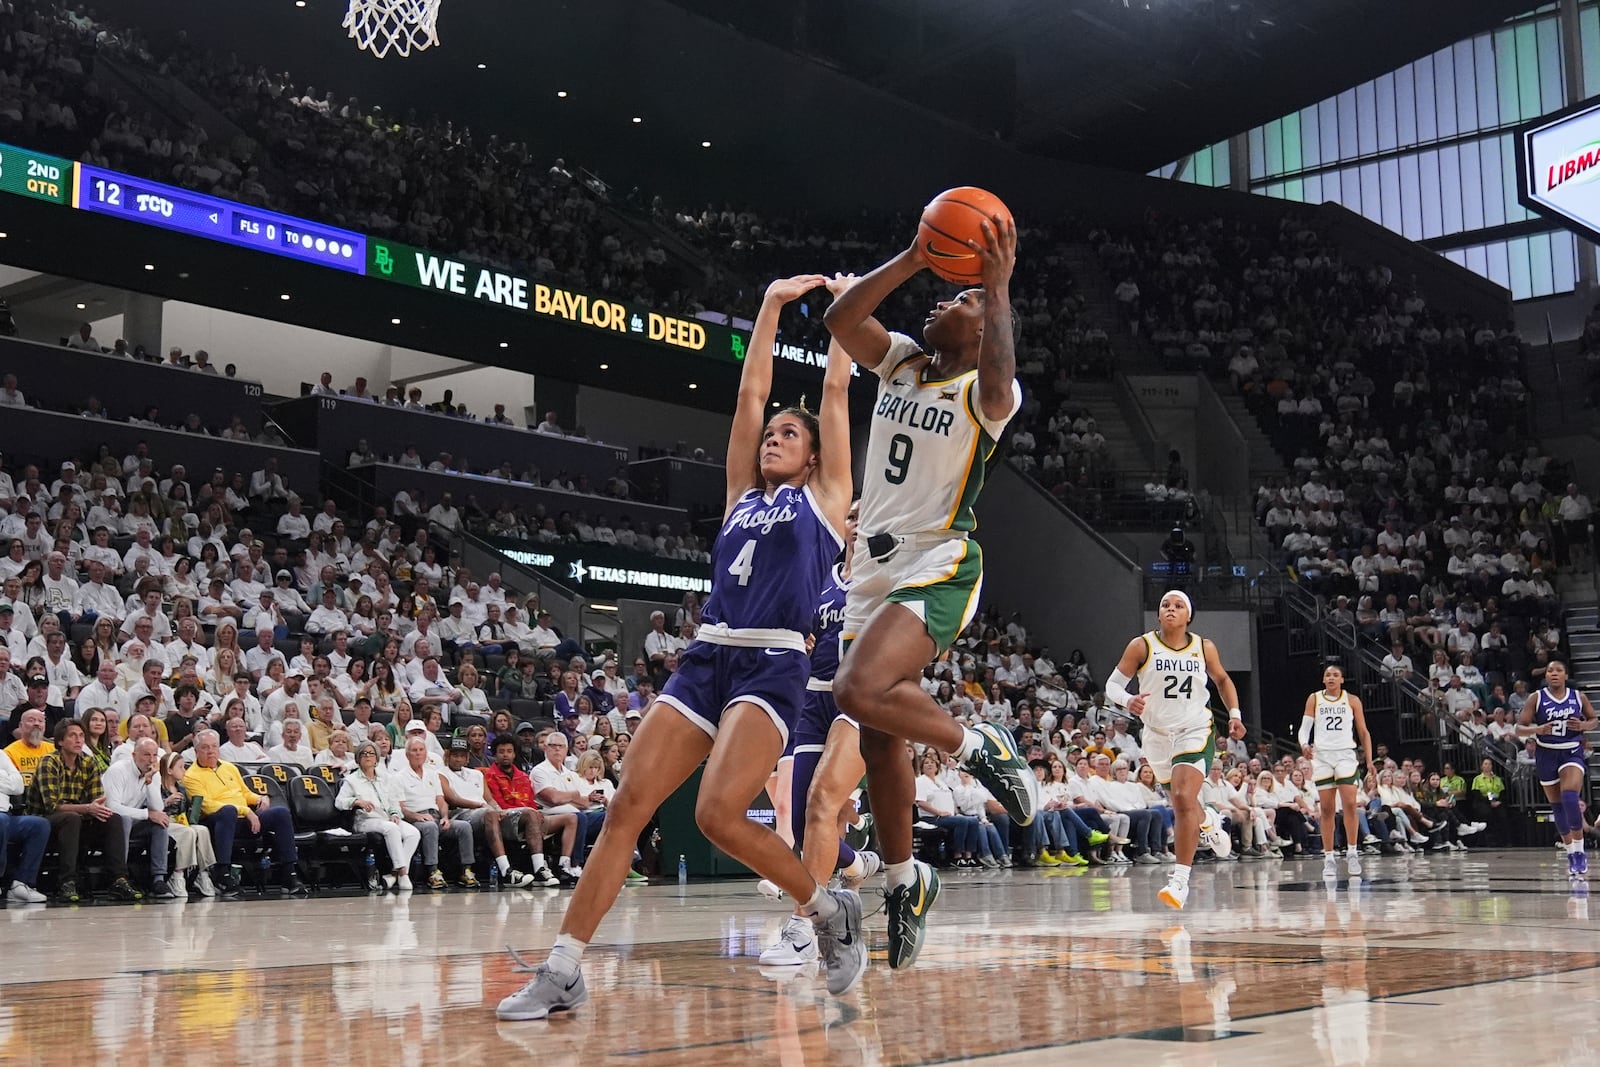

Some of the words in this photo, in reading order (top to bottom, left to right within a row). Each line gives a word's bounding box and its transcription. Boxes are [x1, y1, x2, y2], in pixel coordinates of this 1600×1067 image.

[27, 160, 60, 180] 2ND
[27, 179, 58, 197] QTR
[96, 180, 120, 205] 12
[136, 194, 174, 217] TCU
[240, 219, 260, 234] FLS
[266, 224, 276, 240] 0
[286, 231, 299, 244] TO
[415, 252, 466, 295] WE
[474, 269, 528, 310] ARE
[535, 284, 626, 333] BAYLOR
[648, 312, 706, 350] DEED
[781, 344, 804, 363] ARE
[806, 350, 815, 366] A
[244, 385, 261, 397] 120
[320, 398, 337, 410] 119
[876, 392, 954, 437] BAYLOR
[885, 433, 914, 485] 9
[723, 504, 797, 536] Frogs
[728, 539, 757, 586] 4
[588, 566, 627, 585] TEXAS
[627, 570, 659, 588] FARM
[659, 574, 703, 593] BUREAU
[1156, 659, 1200, 673] BAYLOR
[1164, 675, 1193, 699] 24
[1320, 707, 1346, 715] BAYLOR
[1545, 706, 1576, 721] Frogs
[1326, 716, 1343, 731] 22
[1552, 719, 1567, 737] 21
